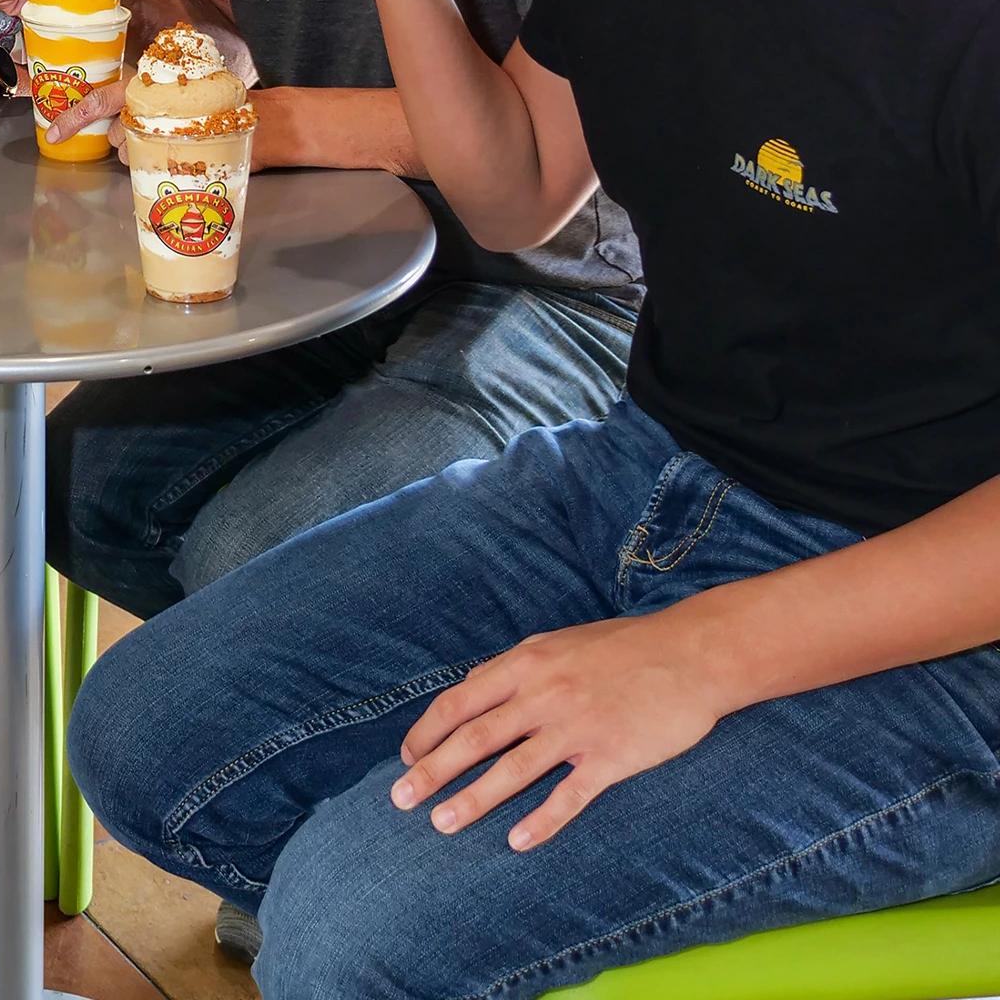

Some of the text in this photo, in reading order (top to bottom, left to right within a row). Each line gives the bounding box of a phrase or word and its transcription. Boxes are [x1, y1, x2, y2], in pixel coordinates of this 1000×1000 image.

[730, 152, 839, 214] DARK SEAS
[745, 179, 813, 213] COAST TO COAST
[156, 193, 229, 215] JEREMIAH'S
[166, 236, 202, 252] ITALIAN
